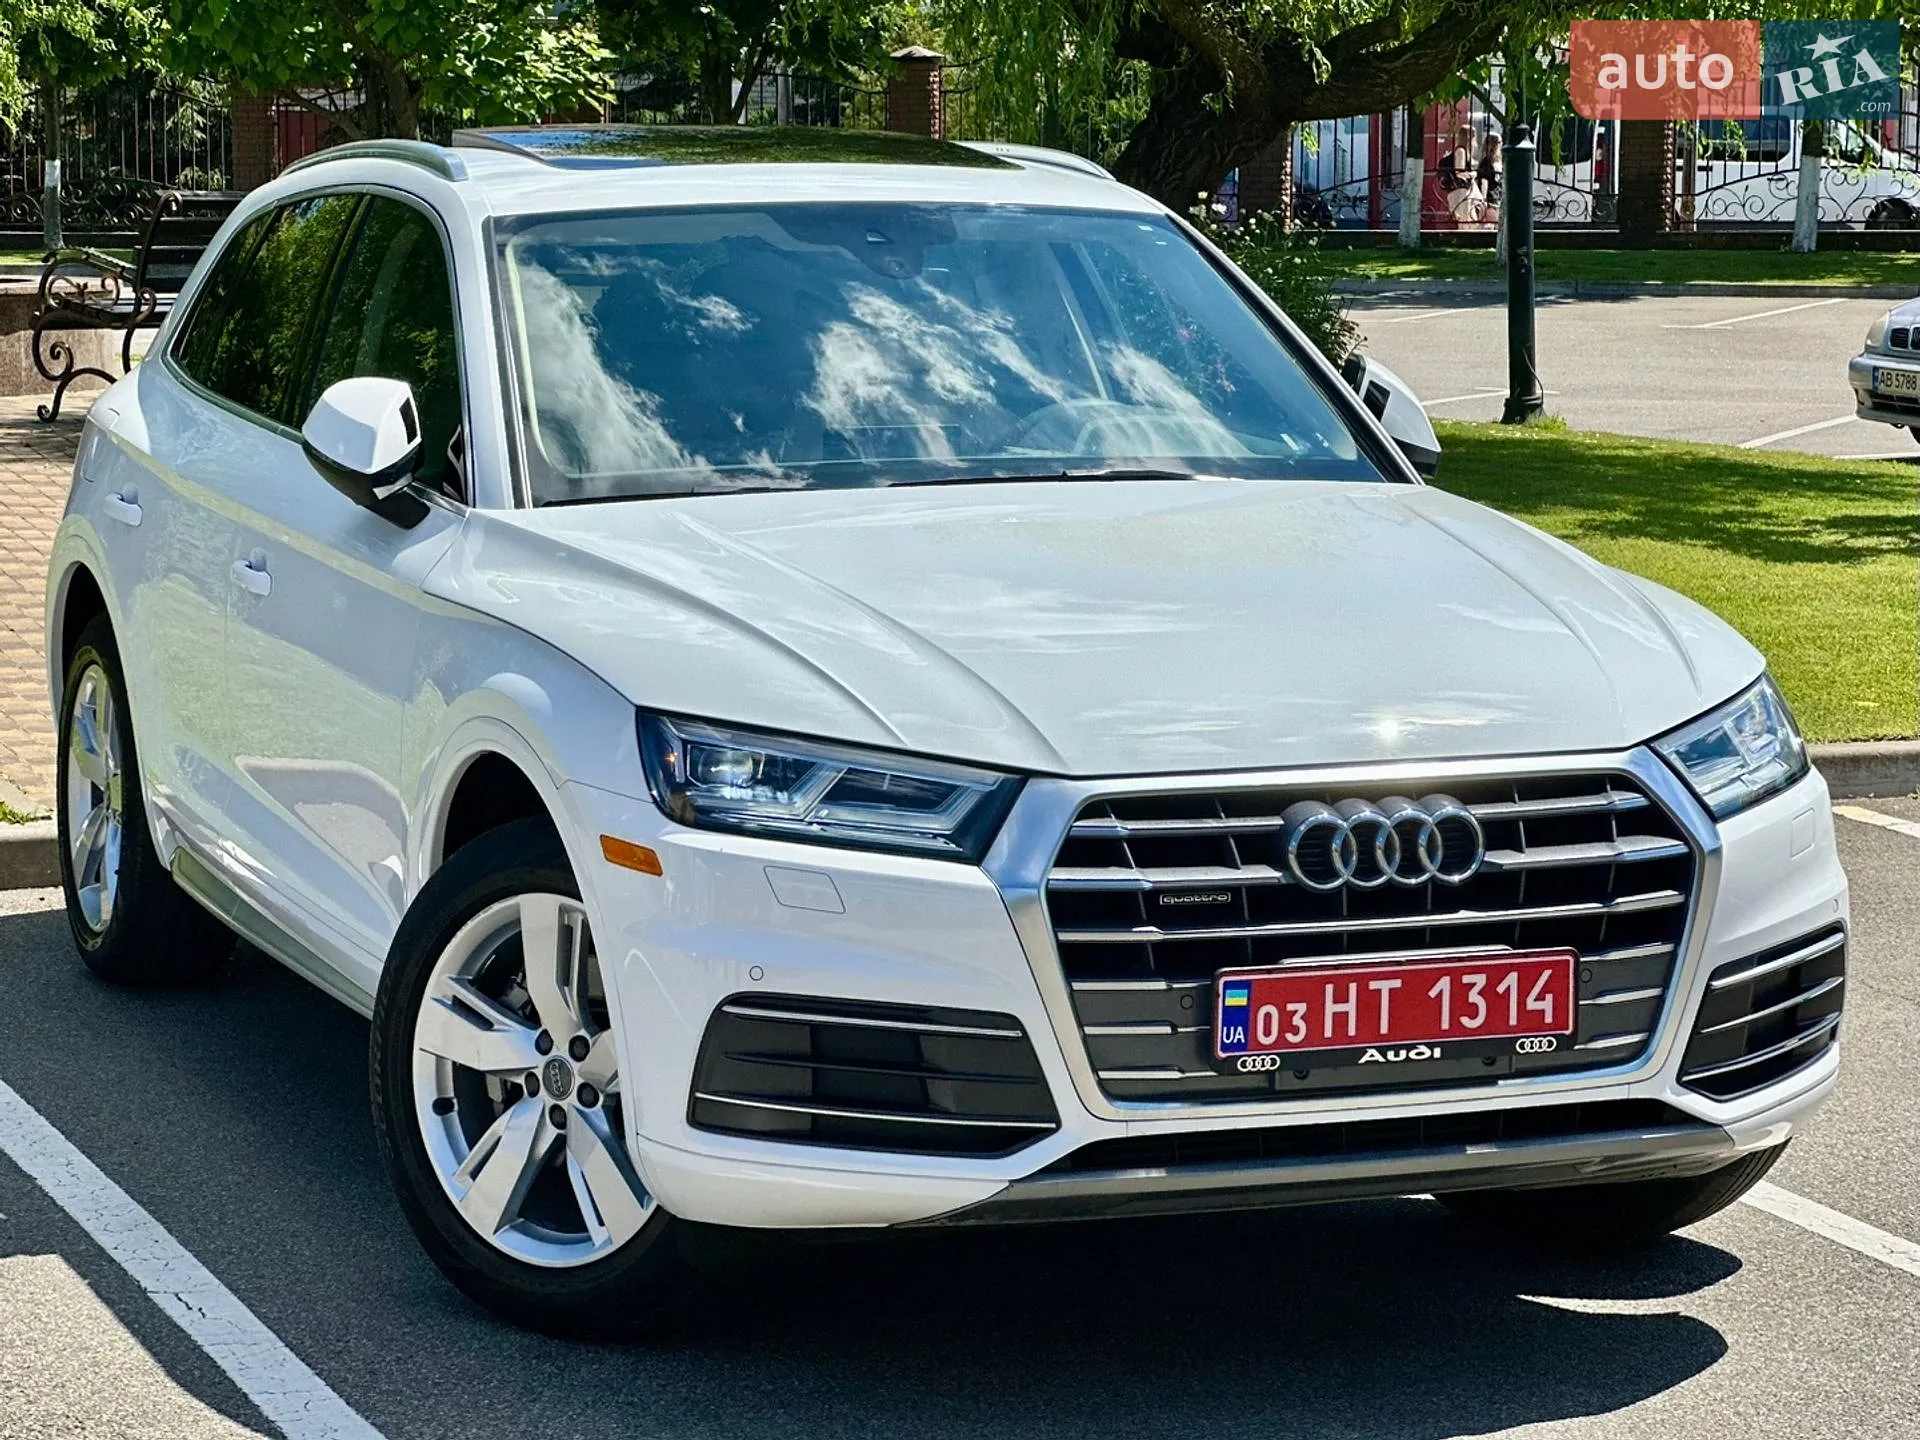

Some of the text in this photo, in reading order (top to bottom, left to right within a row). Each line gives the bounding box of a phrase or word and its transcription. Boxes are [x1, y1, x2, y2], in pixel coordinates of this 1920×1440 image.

[1880, 371, 1893, 388] AB
[1895, 373, 1917, 390] 5788
[1163, 894, 1228, 905] quattro
[1256, 969, 1554, 1046] 03 HT 1314
[1222, 1026, 1246, 1044] UA
[1358, 1045, 1442, 1064] Audi
